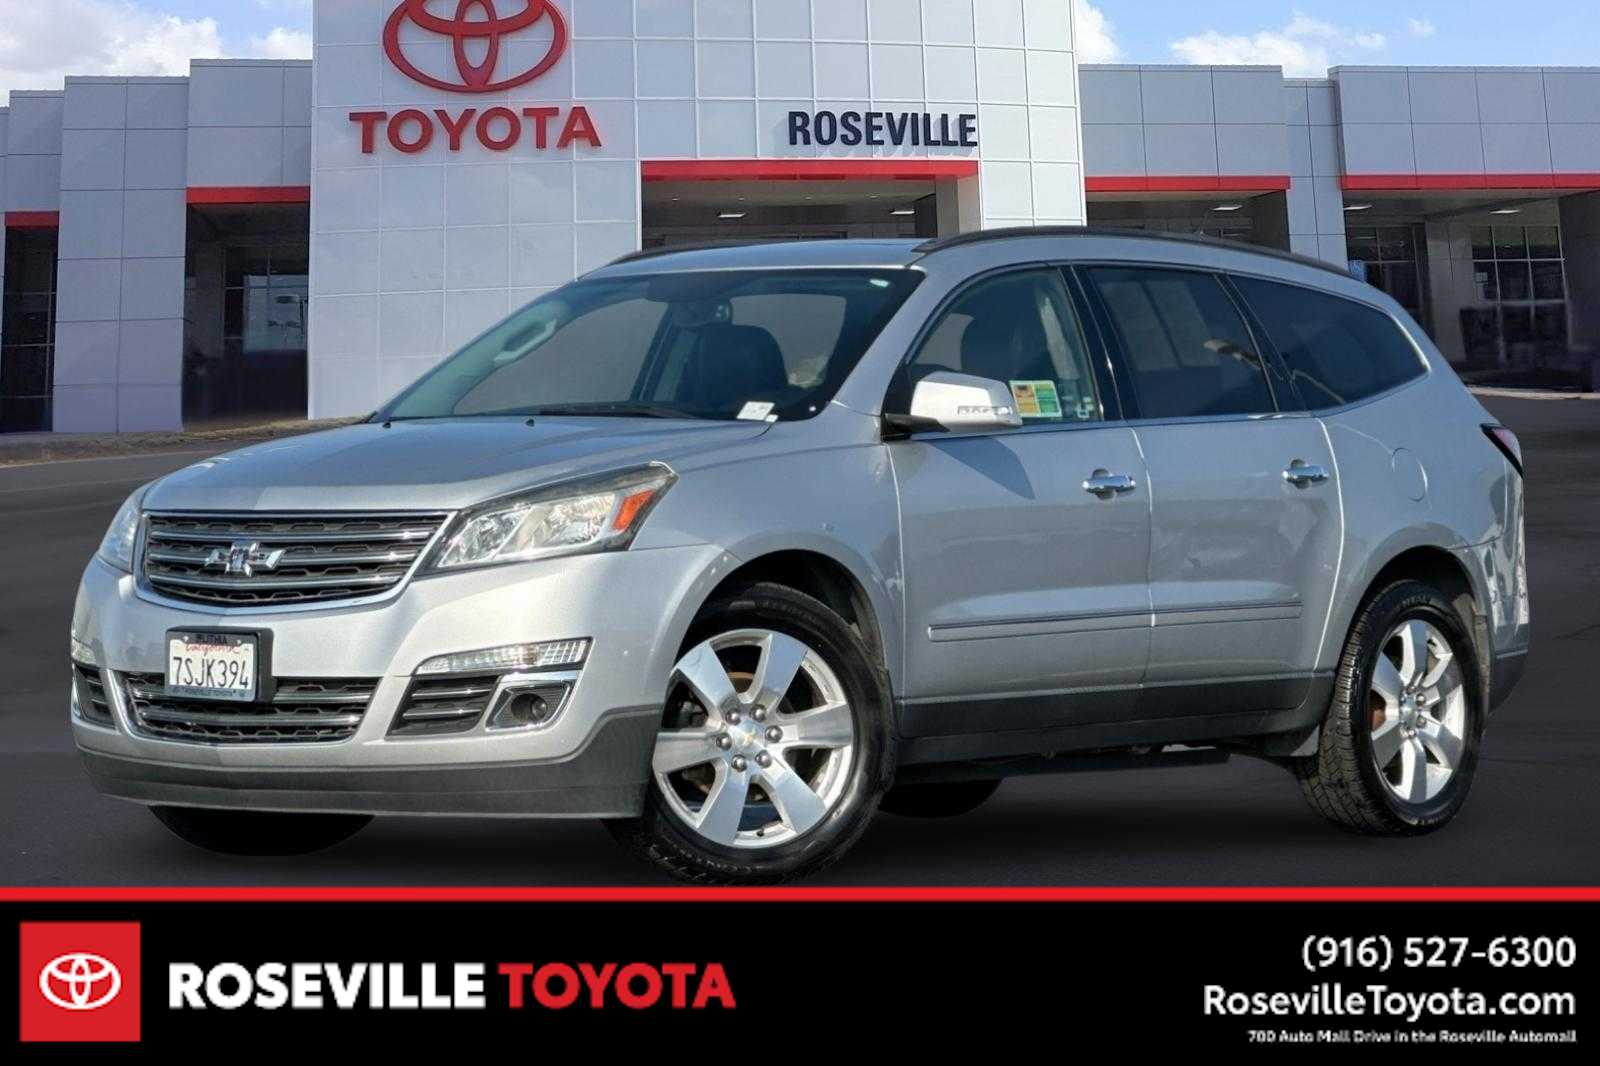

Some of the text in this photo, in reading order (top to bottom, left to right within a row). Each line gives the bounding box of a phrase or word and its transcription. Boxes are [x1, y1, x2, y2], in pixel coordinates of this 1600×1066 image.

[349, 106, 602, 154] TOYOTA
[788, 110, 978, 147] ROSEVILLE
[173, 656, 249, 689] 7SJK394
